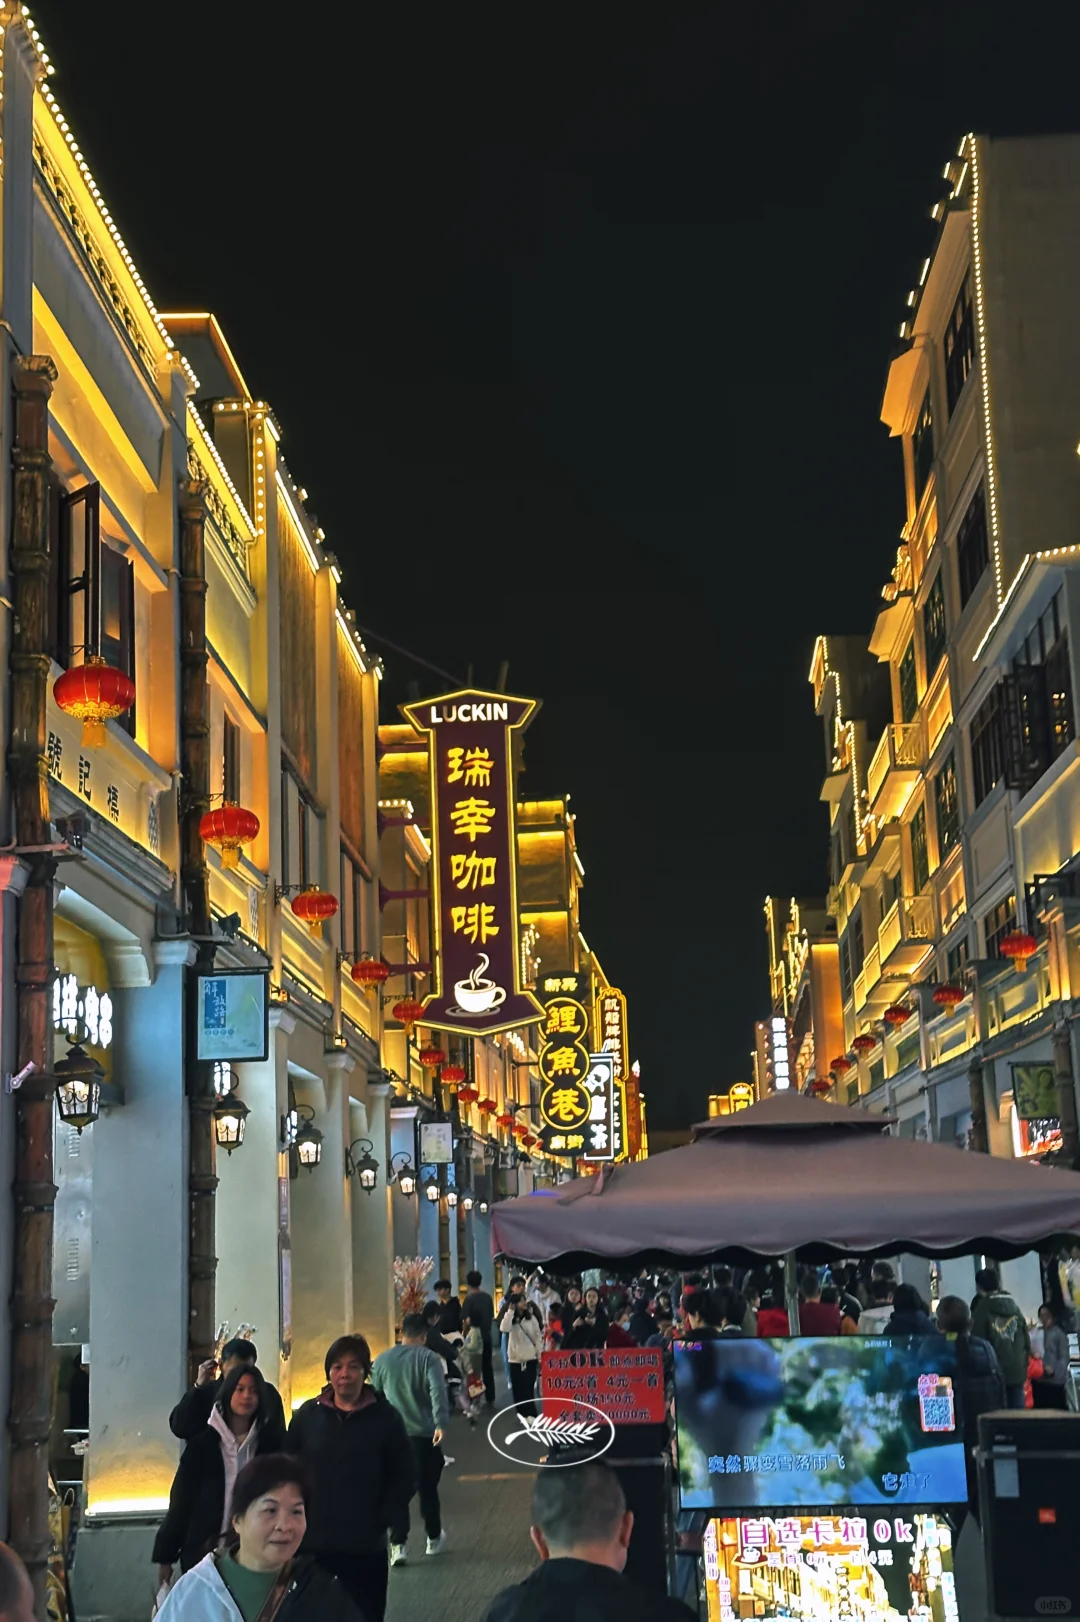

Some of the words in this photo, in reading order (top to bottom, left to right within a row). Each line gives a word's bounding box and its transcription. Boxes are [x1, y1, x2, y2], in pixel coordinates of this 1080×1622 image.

[430, 703, 509, 724] LUCKIN
[447, 746, 500, 945] 瑞幸咖啡
[708, 1453, 846, 1474] 突然骤变雪落雨飞
